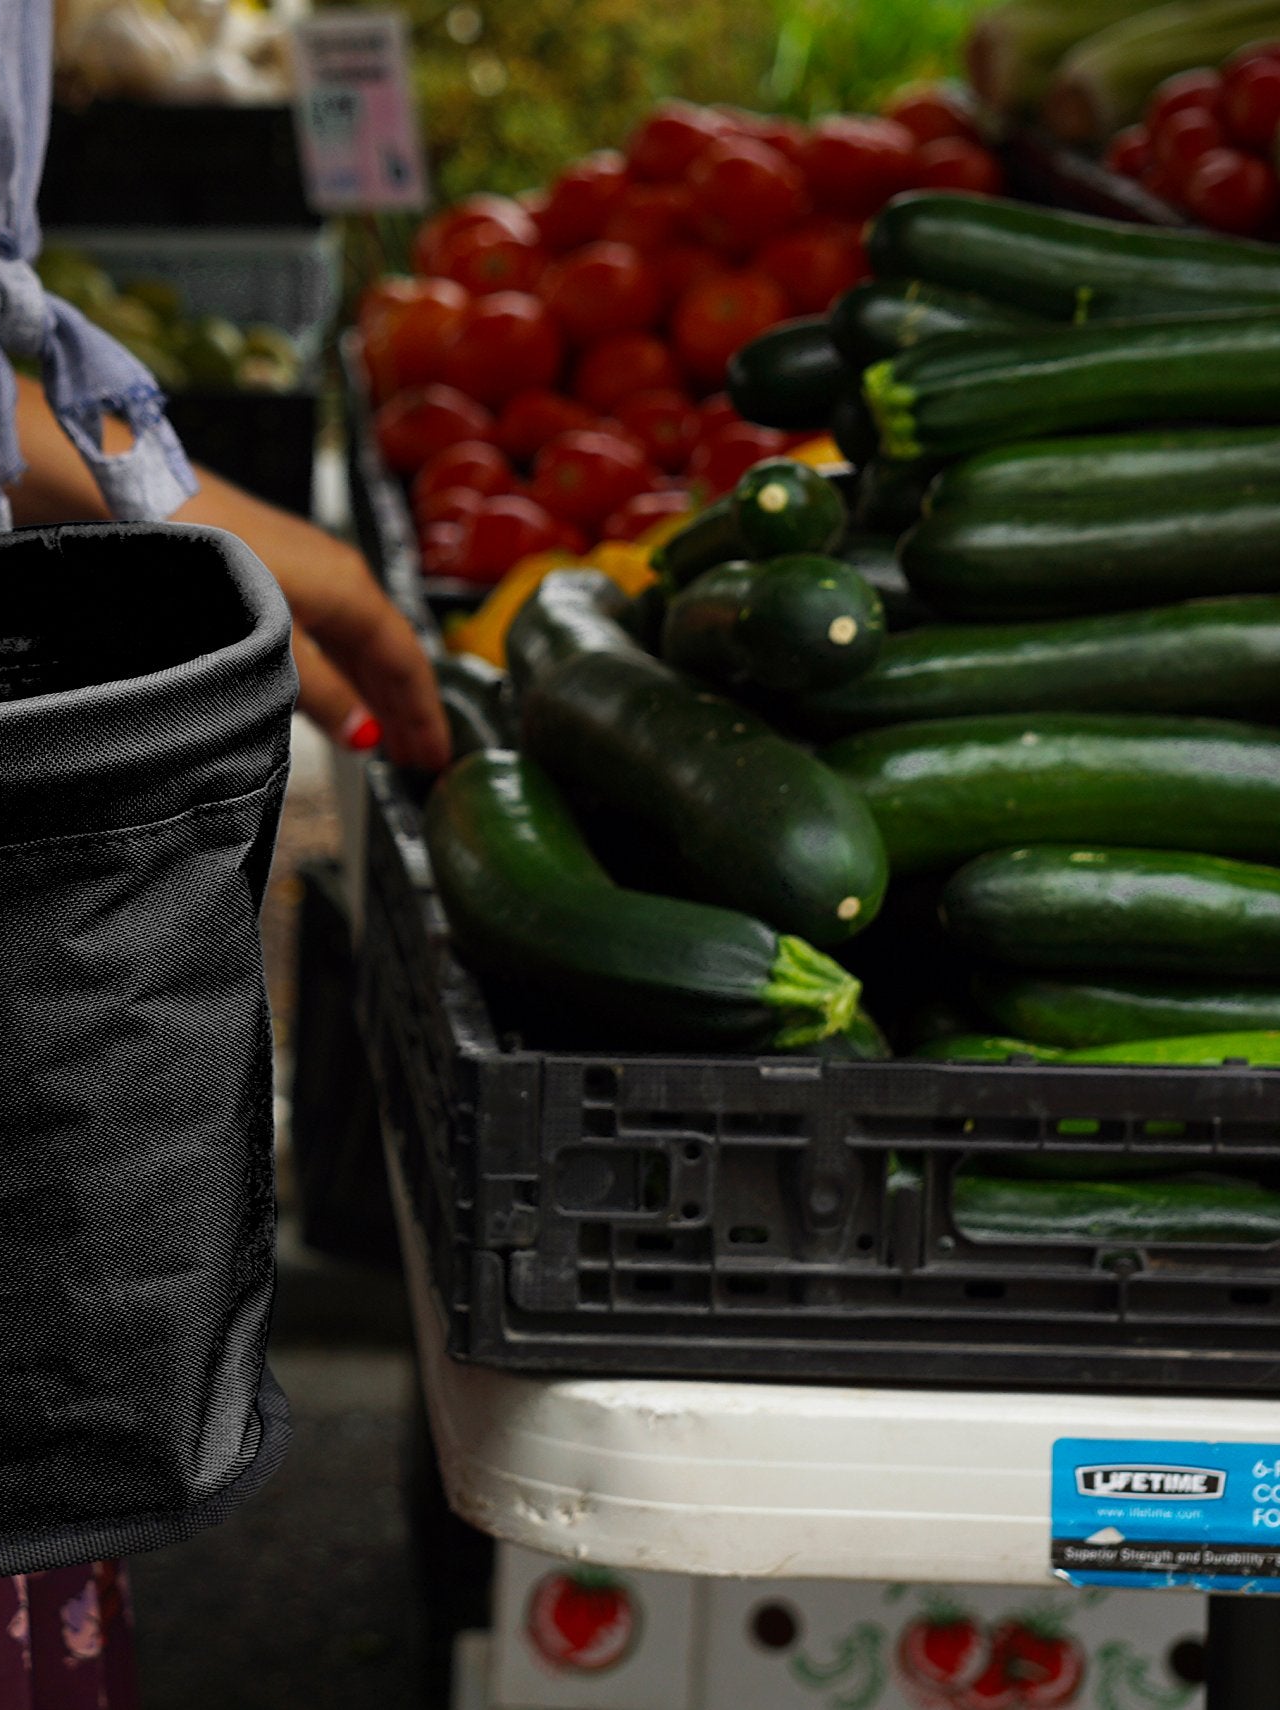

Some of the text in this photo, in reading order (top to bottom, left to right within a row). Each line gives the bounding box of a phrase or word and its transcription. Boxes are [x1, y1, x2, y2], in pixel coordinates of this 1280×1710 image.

[1093, 1471, 1209, 1494] LIFETIME
[1253, 1508, 1280, 1528] FO
[1064, 1547, 1118, 1563] Superior
[1120, 1549, 1174, 1565] Strength
[1177, 1552, 1201, 1563] and
[1203, 1551, 1264, 1567] Durability
